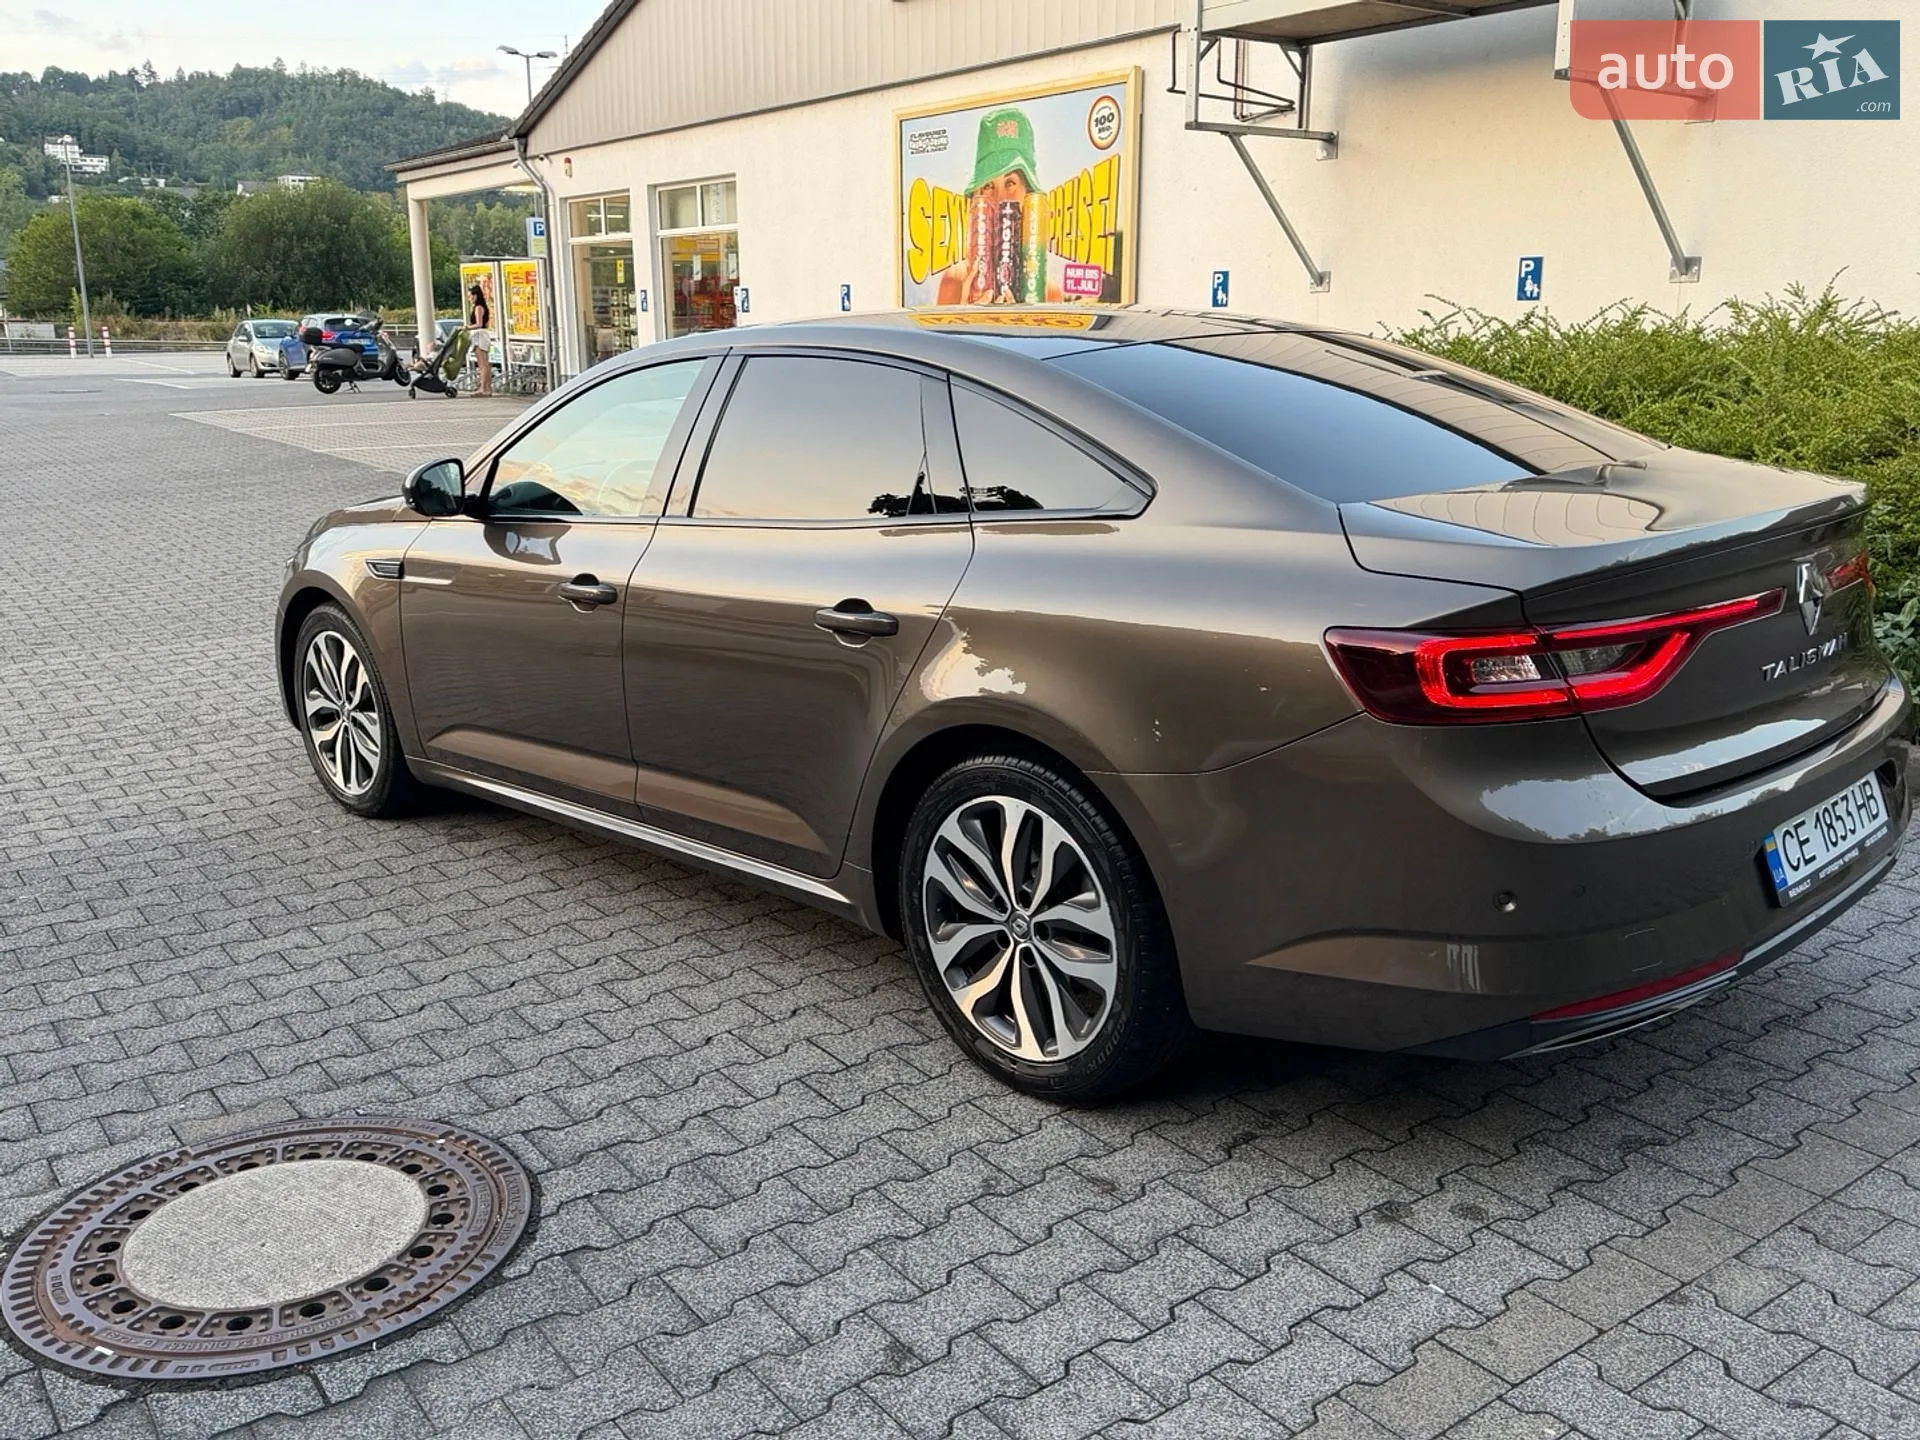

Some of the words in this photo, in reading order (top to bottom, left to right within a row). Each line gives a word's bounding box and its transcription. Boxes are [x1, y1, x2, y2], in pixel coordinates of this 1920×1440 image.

[1094, 112, 1115, 128] 100
[536, 223, 544, 235] P
[1066, 267, 1084, 279] NUR
[1085, 269, 1100, 280] BIS
[1521, 260, 1535, 278] P
[1066, 278, 1079, 291] 11.
[1077, 279, 1100, 292] JULI
[1215, 273, 1224, 289] P
[1760, 632, 1849, 681] TALISMAN
[1782, 820, 1818, 873] CE
[1814, 793, 1857, 853] 1853
[1851, 780, 1880, 829] HB
